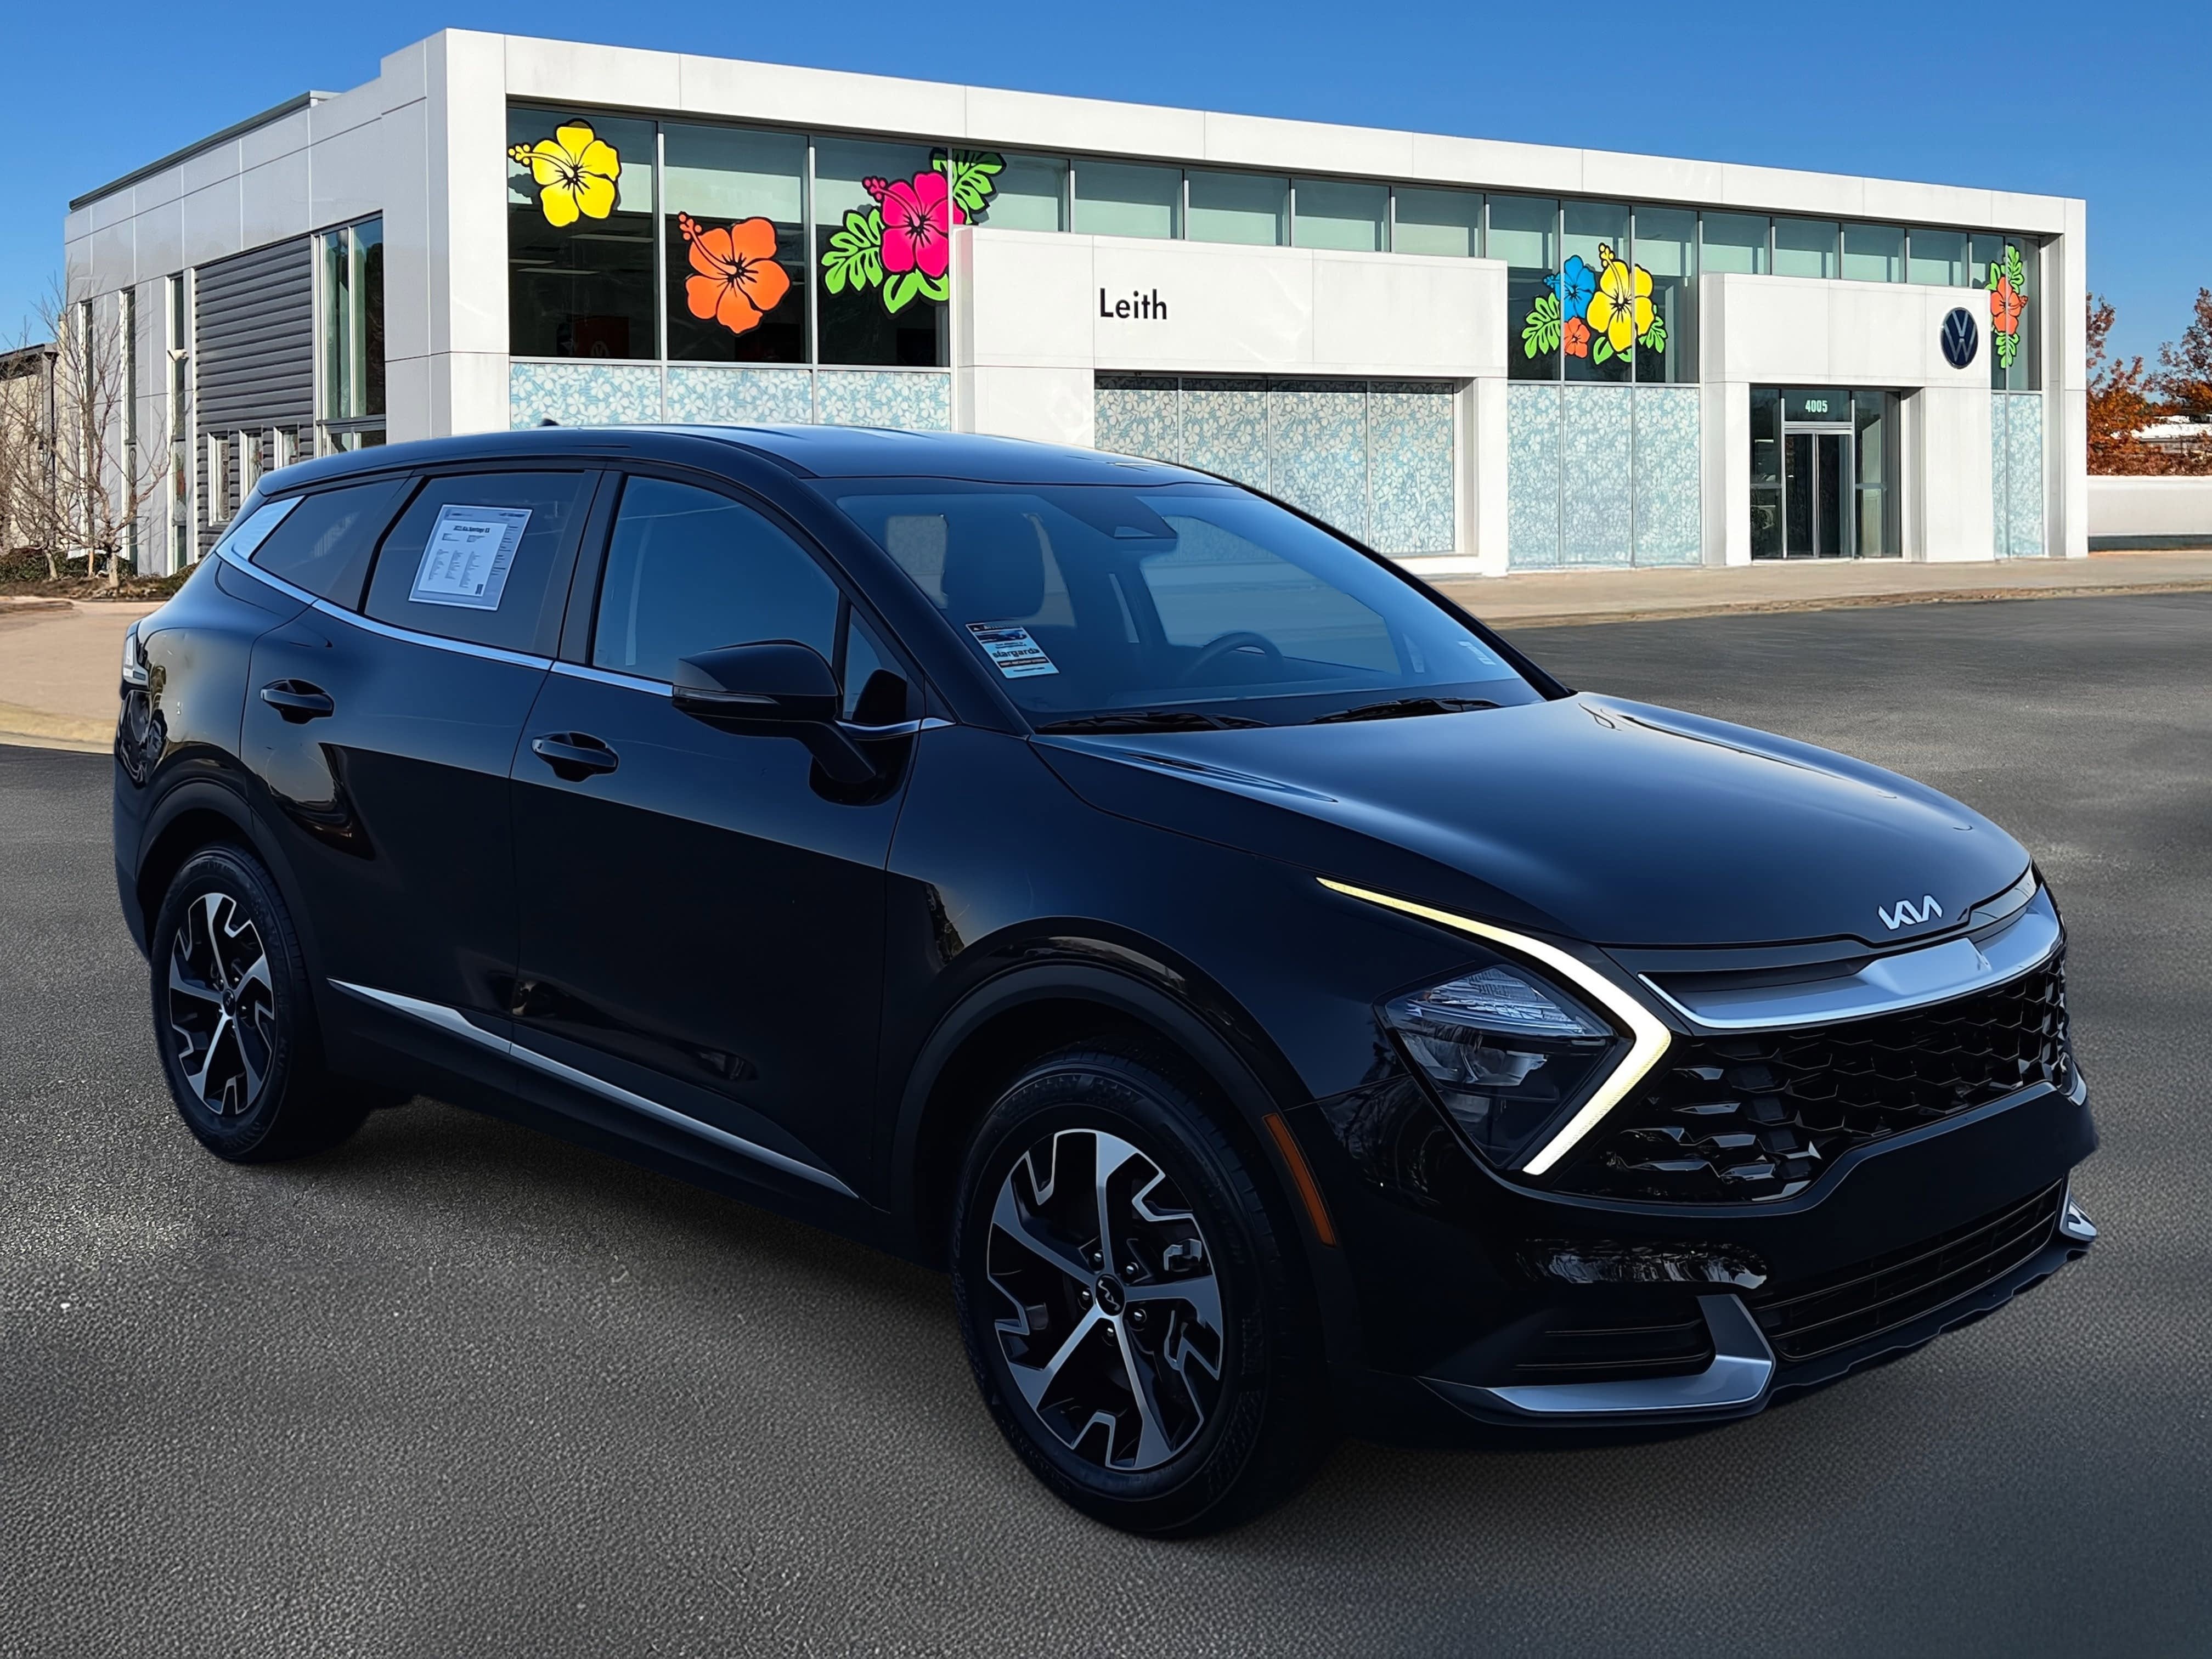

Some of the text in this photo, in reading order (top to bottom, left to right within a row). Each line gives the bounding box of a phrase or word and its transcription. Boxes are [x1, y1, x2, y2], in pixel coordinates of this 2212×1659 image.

[1099, 287, 1167, 320] Leith
[1804, 399, 1829, 413] 4005
[1878, 895, 1943, 930] KIA
